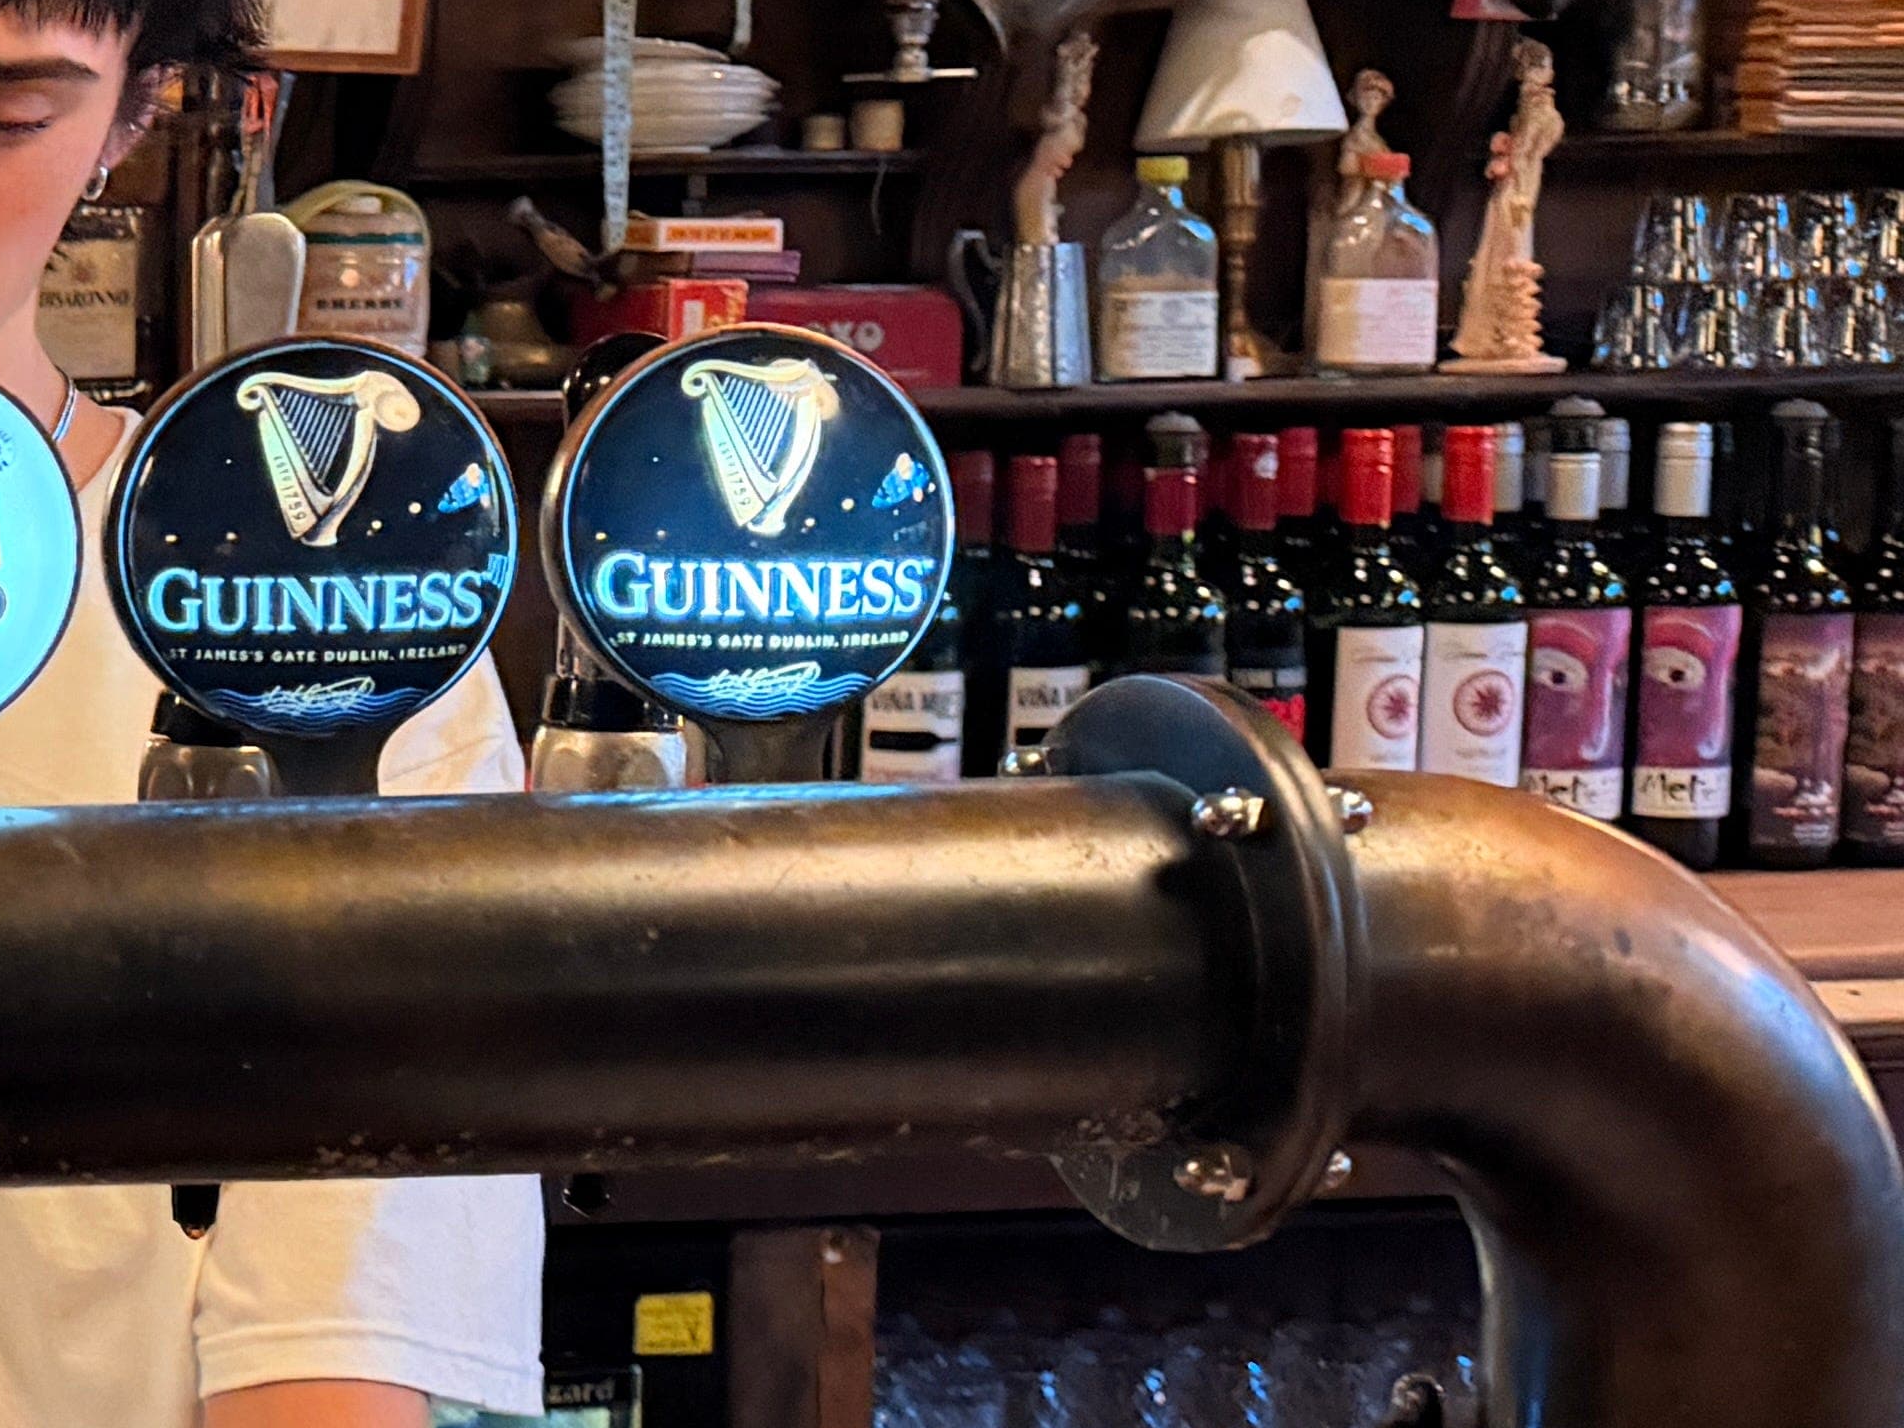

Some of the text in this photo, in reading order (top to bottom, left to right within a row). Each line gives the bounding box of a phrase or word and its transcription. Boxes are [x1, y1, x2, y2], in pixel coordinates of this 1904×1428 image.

[148, 566, 484, 634] GUINNESS
[596, 550, 927, 620] GUINNESS
[194, 648, 263, 661] JAMES'S
[271, 649, 317, 662] GATE
[399, 644, 467, 660] IRELAND
[643, 632, 713, 648] JAMES'S
[719, 634, 764, 649] GATE
[843, 630, 910, 648] IRELAND
